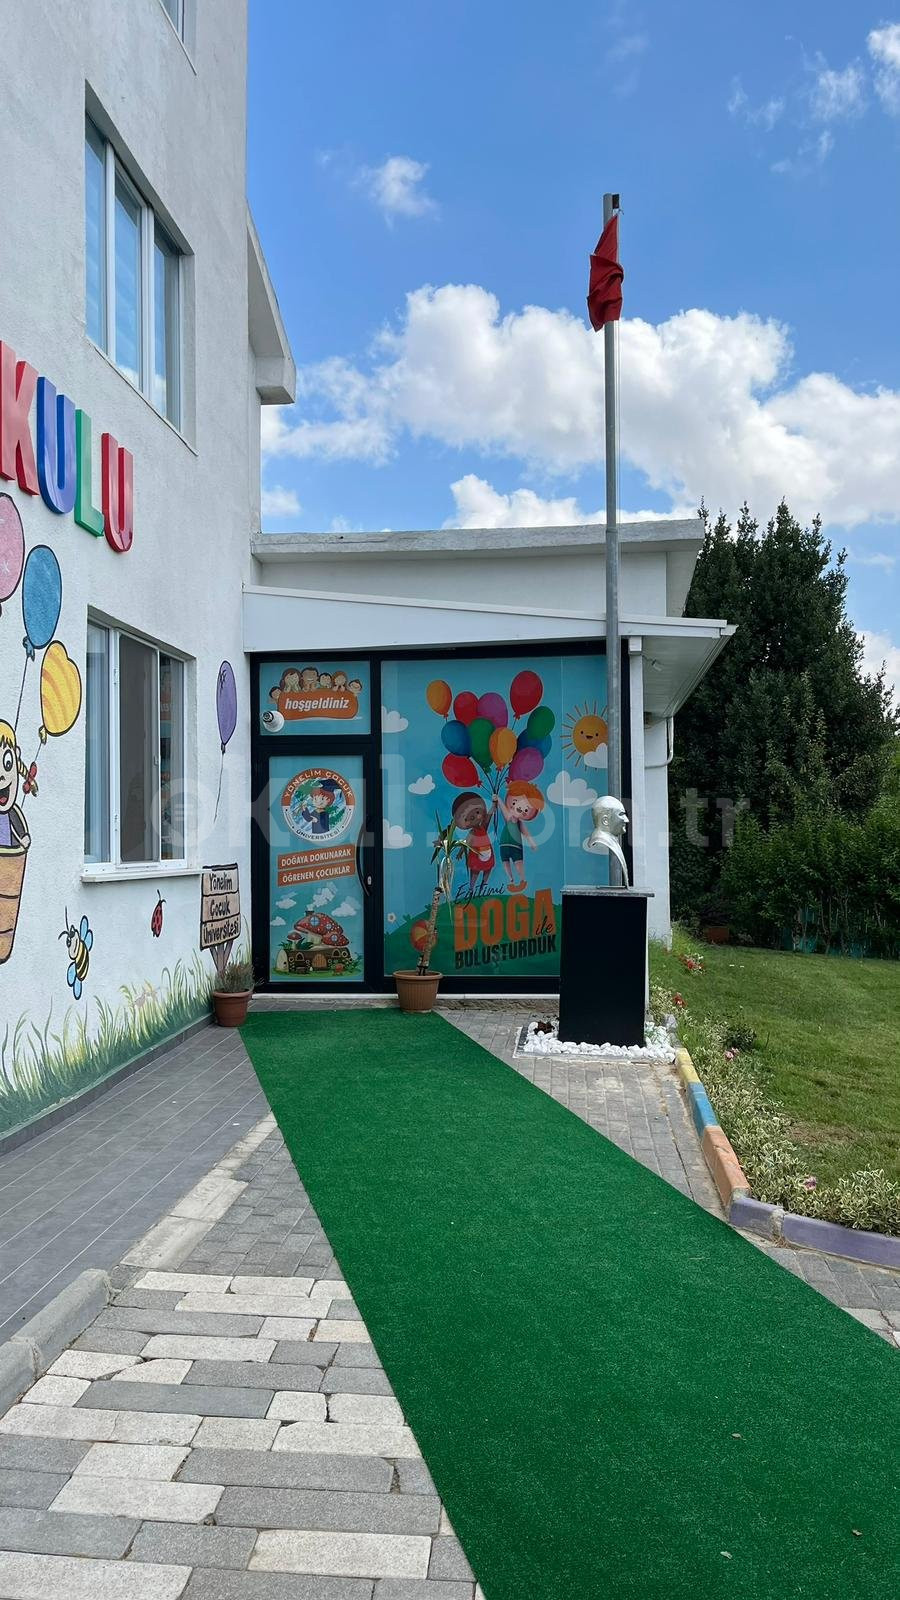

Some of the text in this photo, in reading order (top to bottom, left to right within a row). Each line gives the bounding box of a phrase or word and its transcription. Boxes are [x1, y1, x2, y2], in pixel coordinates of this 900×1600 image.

[284, 697, 350, 713] hoşgeldiniz
[281, 848, 352, 867] DOĞAYA DOKUNARAK
[208, 871, 233, 892] Yönelim
[282, 865, 351, 883] ÖĞRENEN ÇOCUKLAR
[454, 882, 505, 910] Eğitimi
[209, 896, 231, 920] Çocuk
[454, 880, 556, 952] DOĞA
[535, 915, 553, 936] ile
[455, 934, 557, 969] BULUŞTURDUK
